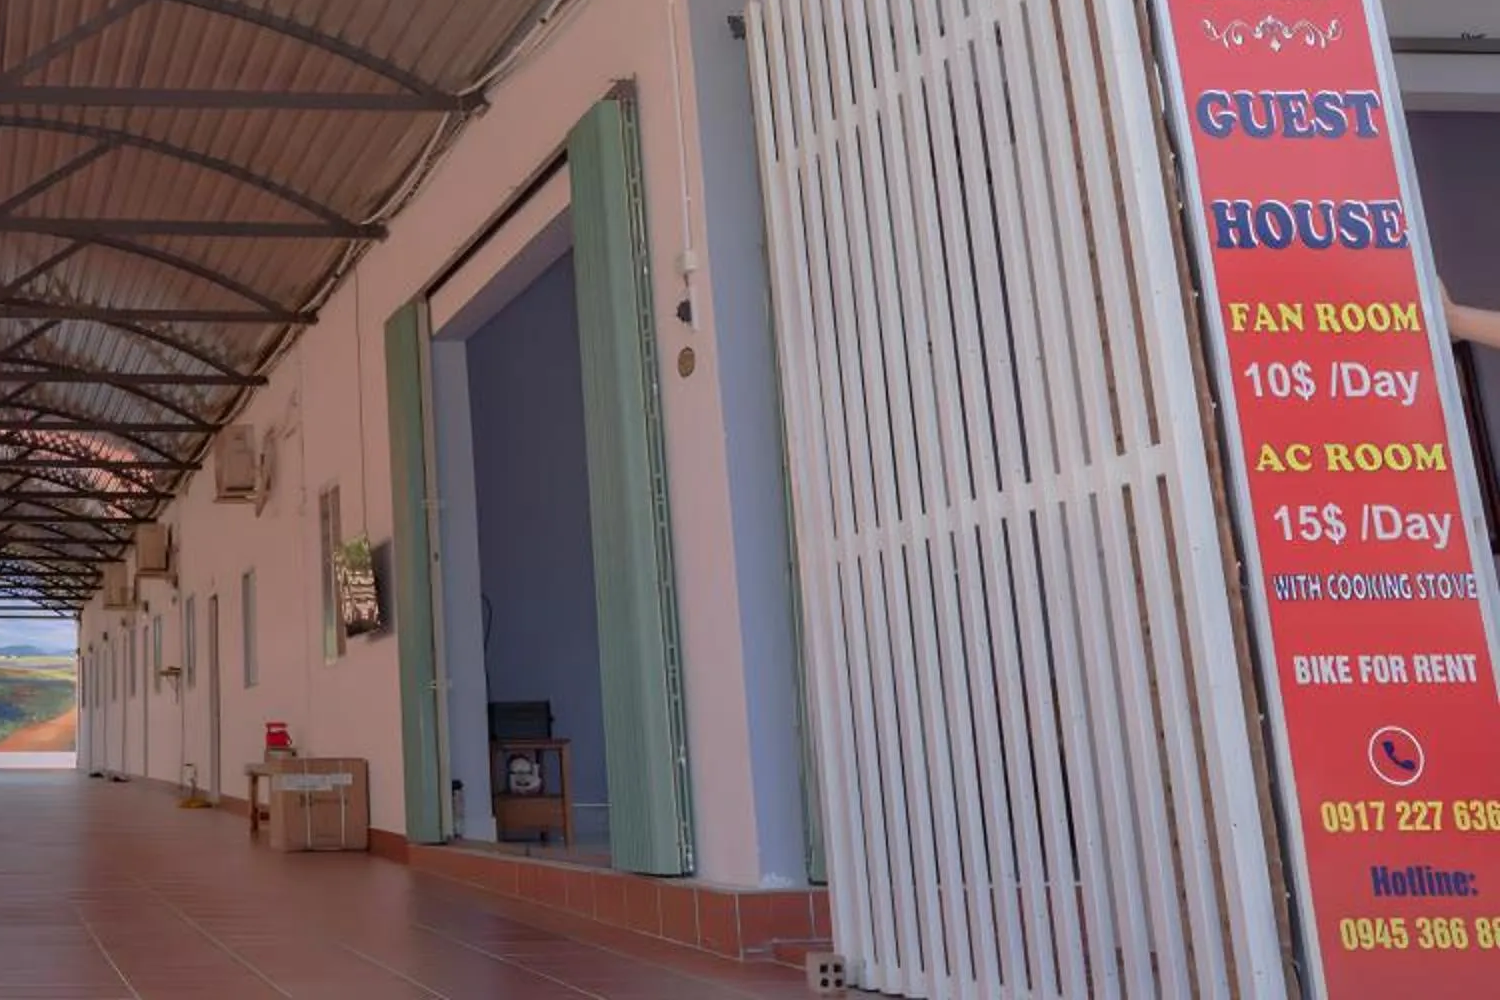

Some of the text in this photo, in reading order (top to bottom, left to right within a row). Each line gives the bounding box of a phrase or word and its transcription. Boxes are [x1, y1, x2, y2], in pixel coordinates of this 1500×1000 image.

[1195, 89, 1381, 139] GUEST
[1211, 199, 1411, 249] HOUSE
[1228, 302, 1422, 333] FAN ROOM
[1244, 360, 1419, 406] 10$ /Day
[1255, 443, 1447, 472] AC ROOM
[1273, 502, 1451, 549] 15$ /Day
[1272, 572, 1478, 600] WITH COOKING STOVE
[1293, 654, 1477, 685] BIKE FOR RENT
[1320, 800, 1500, 833] 0917 227 636
[1370, 865, 1479, 897] Hotline:
[1339, 917, 1409, 950] 0945
[1415, 917, 1469, 950] 366
